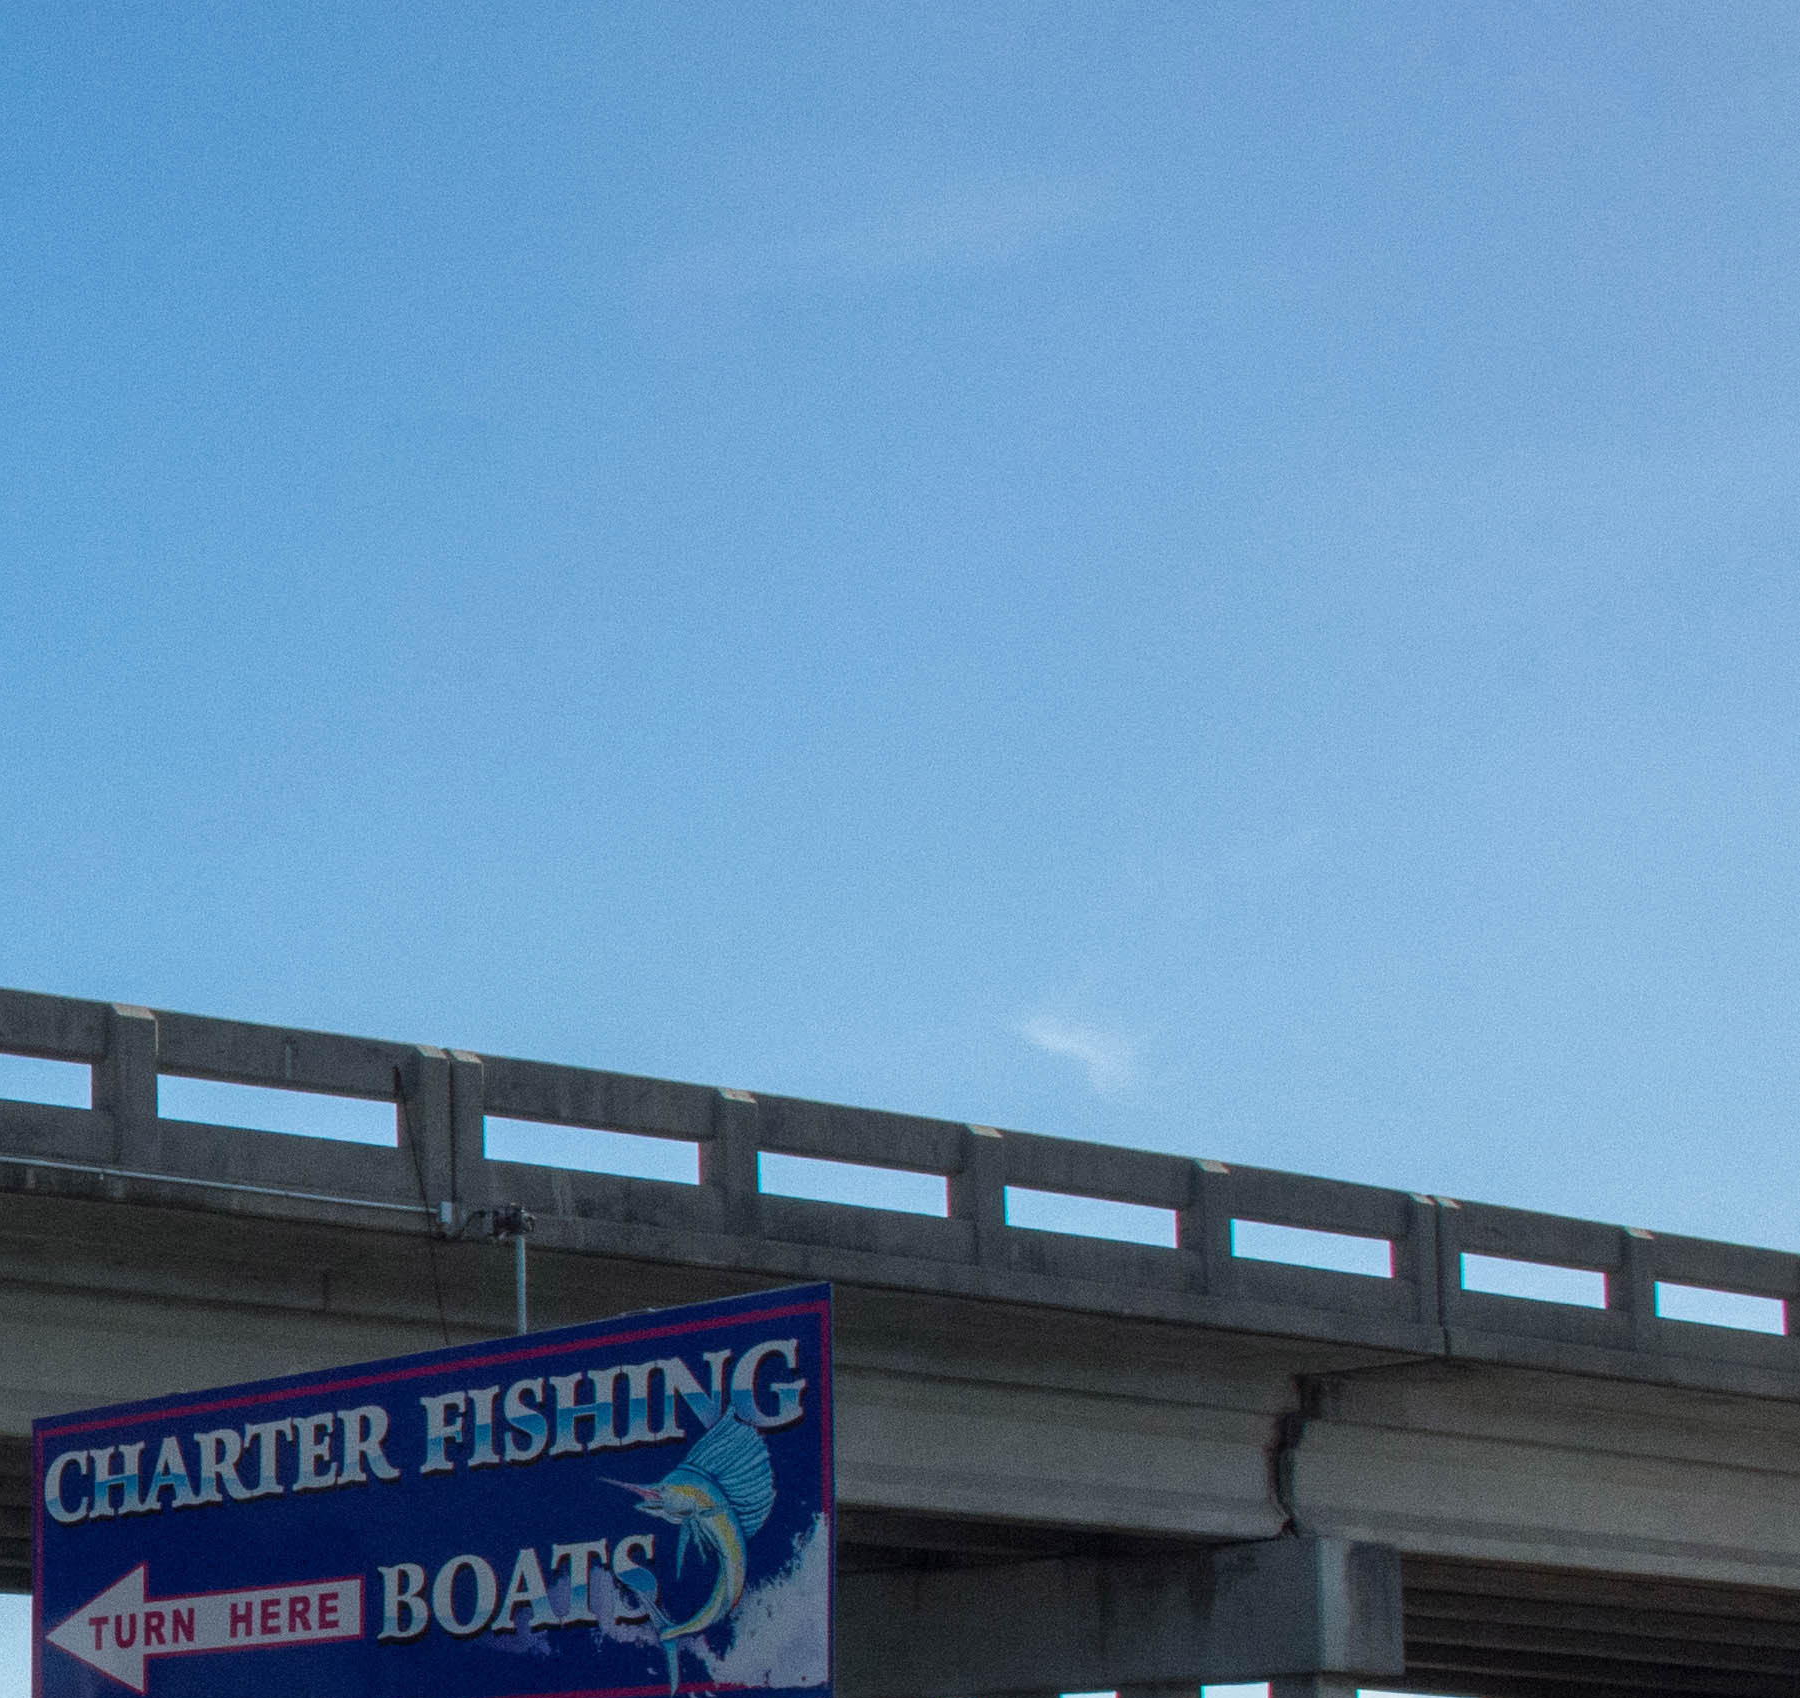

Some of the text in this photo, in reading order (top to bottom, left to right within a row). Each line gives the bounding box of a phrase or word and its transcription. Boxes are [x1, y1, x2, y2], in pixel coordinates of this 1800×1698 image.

[44, 1339, 806, 1524] CHARTER FISHING
[88, 1592, 340, 1650] TURN HERE
[377, 1534, 658, 1641] BOATS
